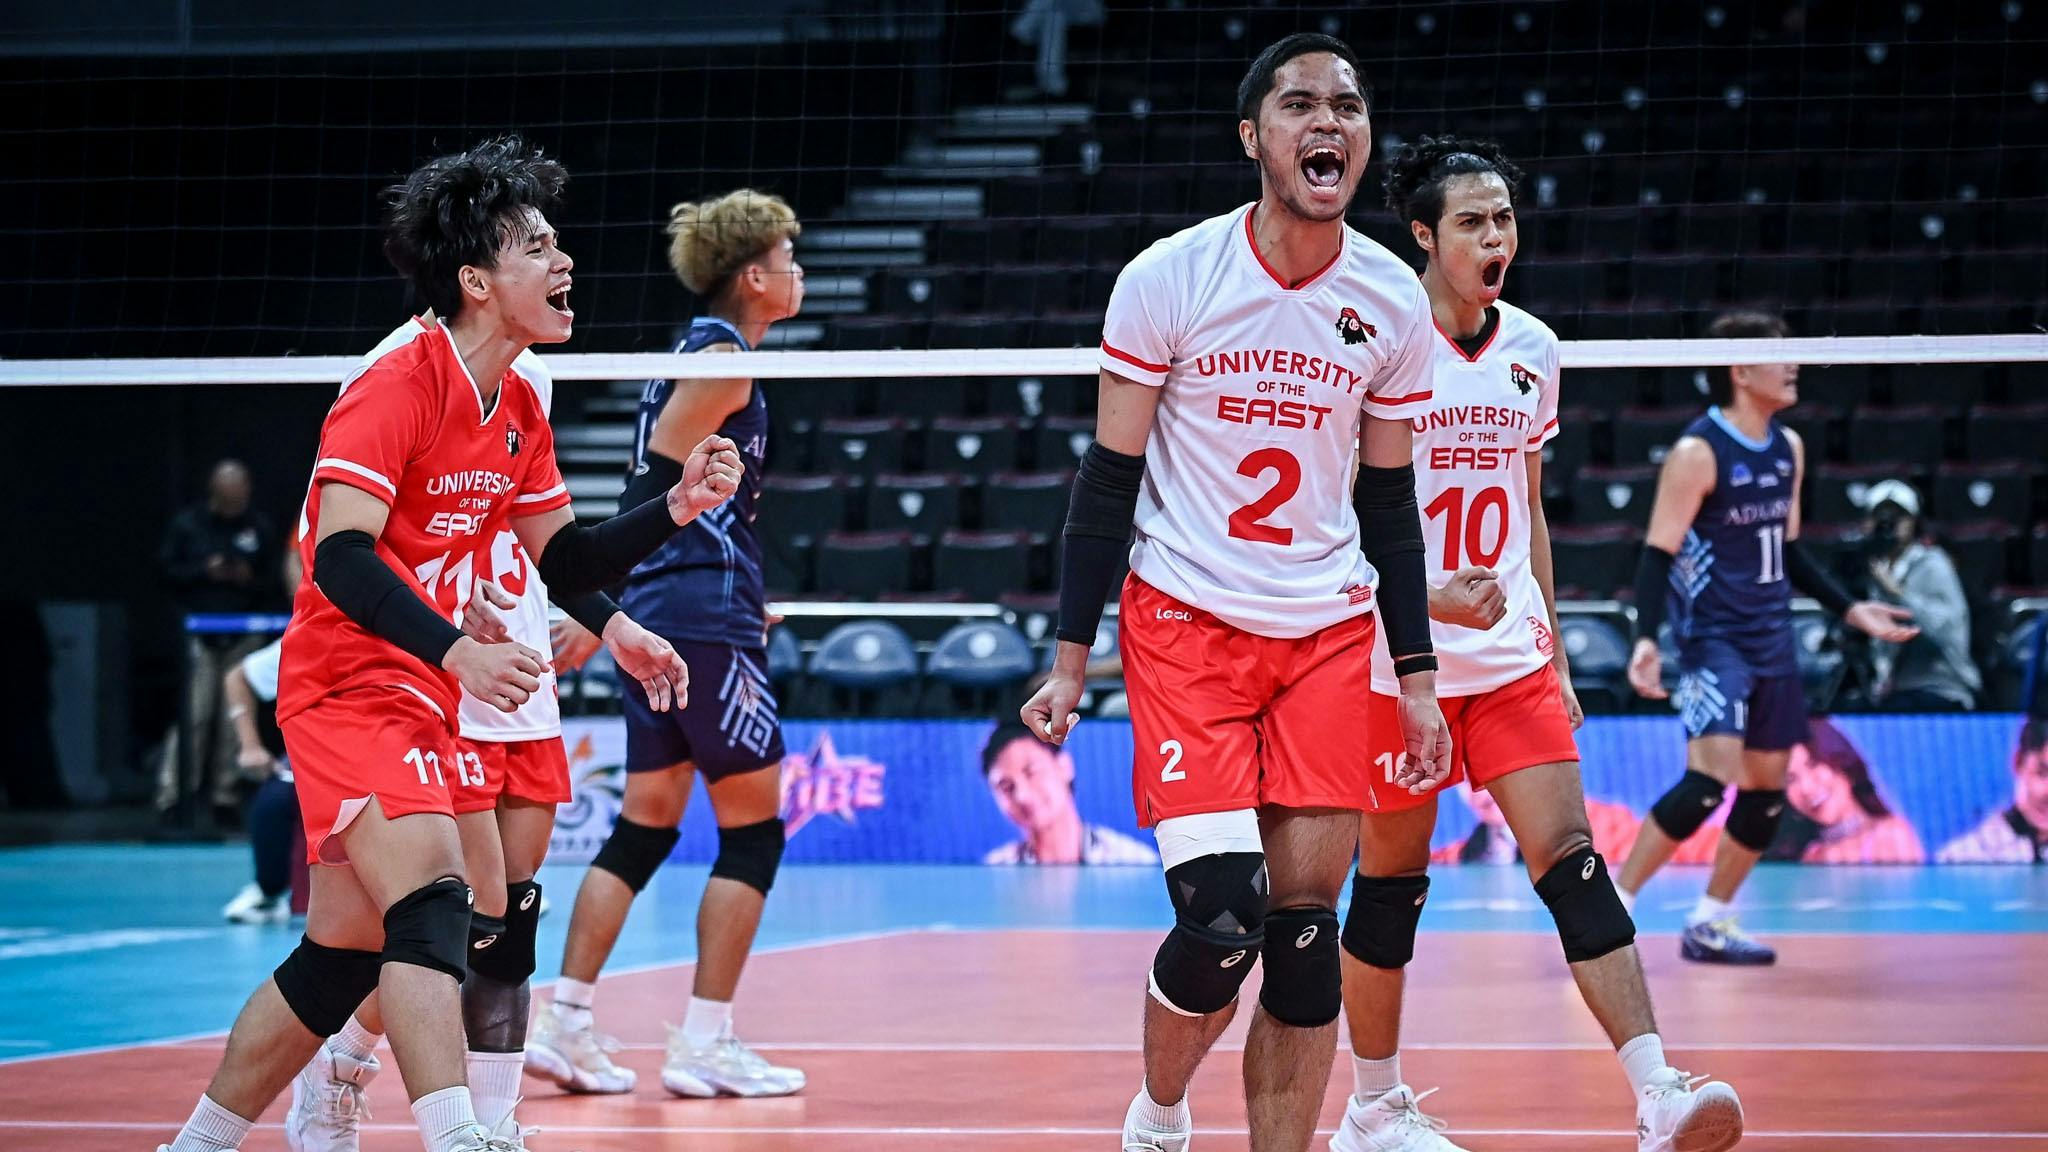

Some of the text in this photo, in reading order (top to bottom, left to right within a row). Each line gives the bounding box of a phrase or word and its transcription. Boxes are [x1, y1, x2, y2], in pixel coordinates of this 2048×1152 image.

[1197, 350, 1361, 395] UNIVERSITY
[1257, 381, 1306, 397] OF THE
[1217, 395, 1333, 430] EAST
[1413, 406, 1534, 434] UNIVERSITY
[1459, 432, 1499, 443] OF THE
[1430, 447, 1518, 470] EAST
[1228, 447, 1302, 546] 2
[1423, 486, 1509, 571] 10
[402, 748, 445, 787] 11
[456, 751, 486, 787] 13
[1159, 739, 1186, 783] 2
